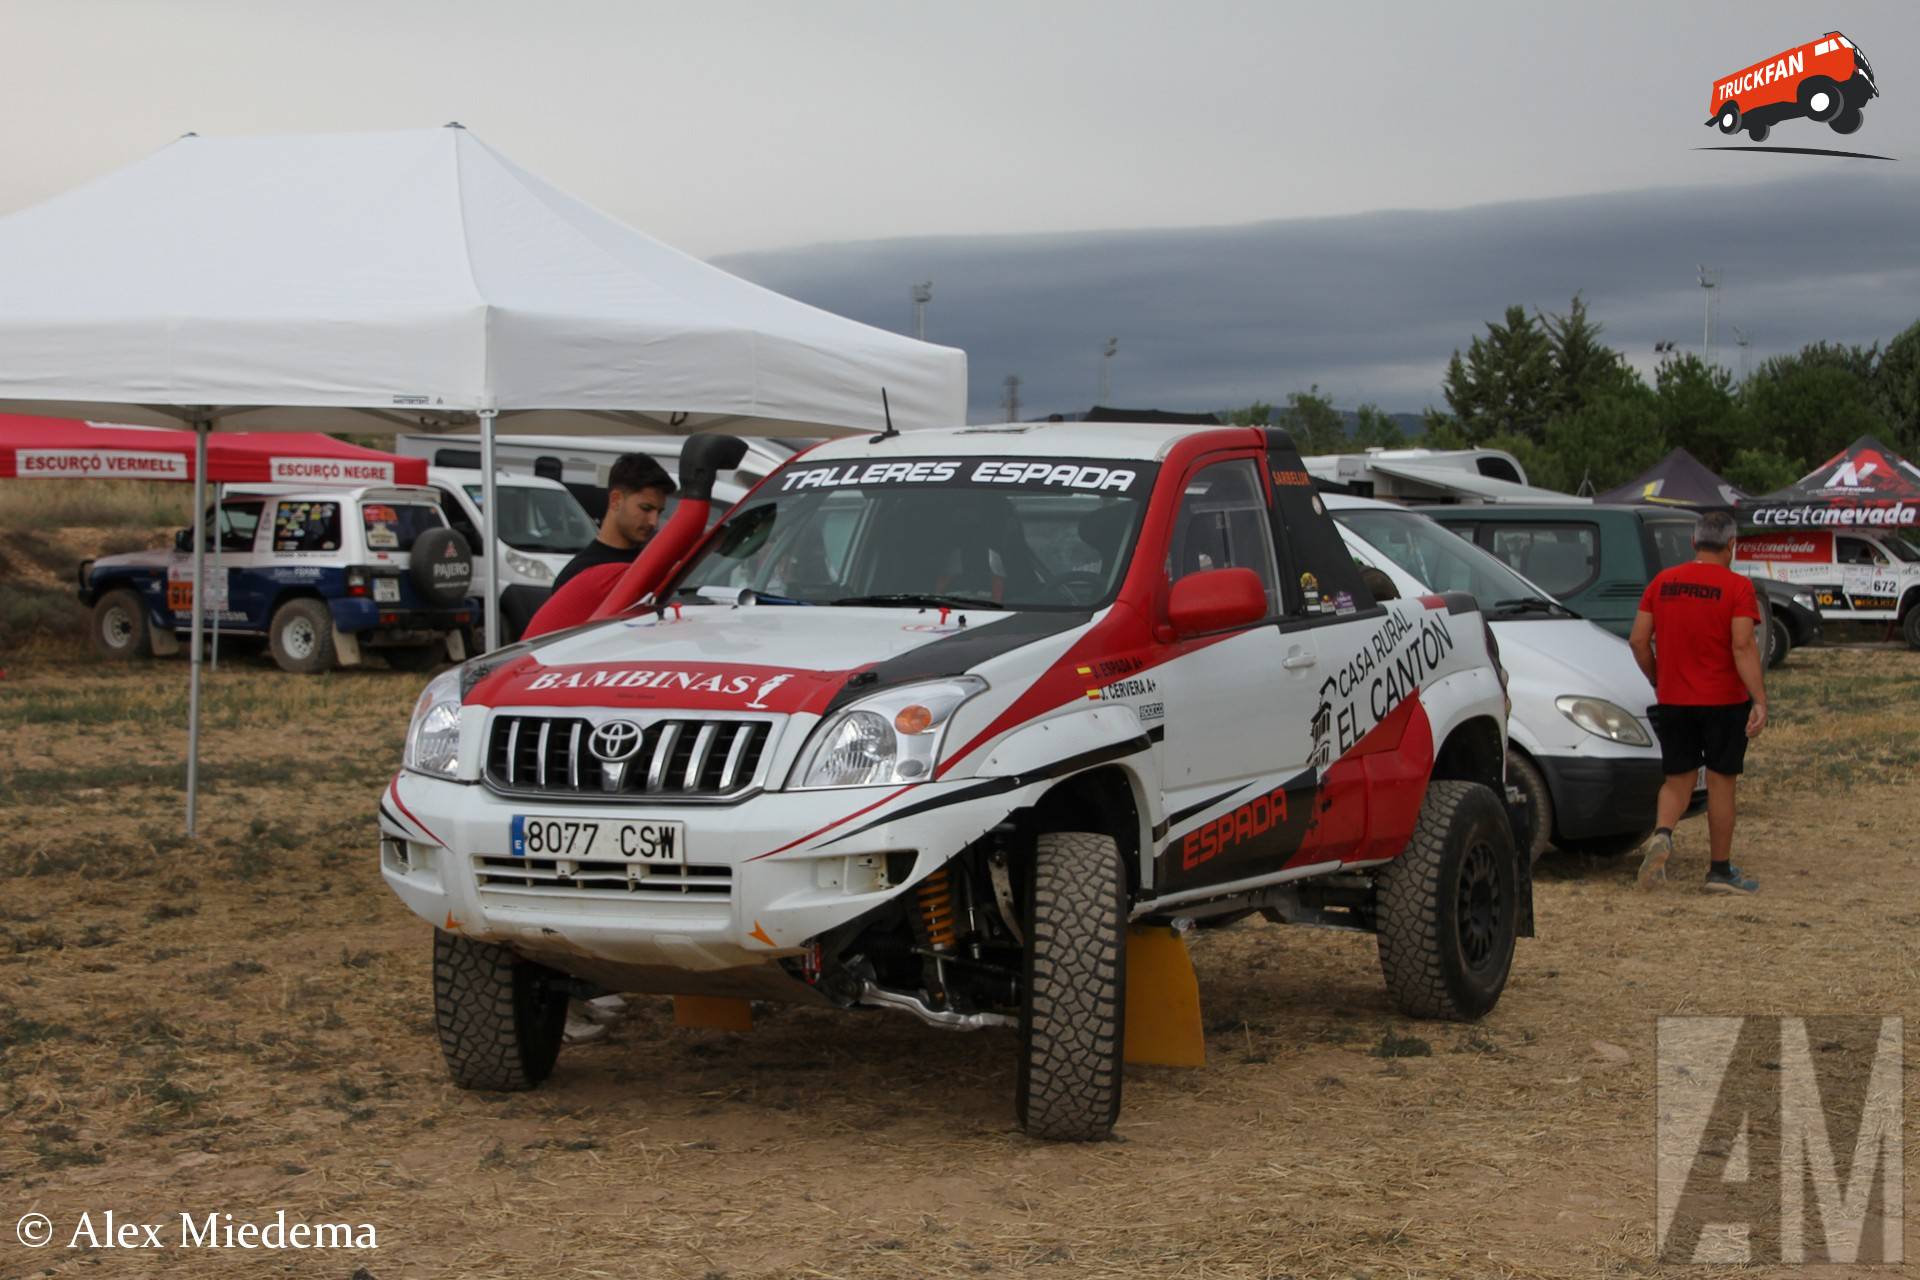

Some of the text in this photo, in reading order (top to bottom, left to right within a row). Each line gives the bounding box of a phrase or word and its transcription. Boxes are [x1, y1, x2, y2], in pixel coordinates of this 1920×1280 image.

[25, 454, 176, 473] ESCURÇÓ VERMELL
[278, 462, 386, 480] ESCURÇÓ NEGRE
[781, 461, 1136, 492] TALLERES ESPADA
[1752, 502, 1917, 526] crestanevada
[433, 562, 470, 578] PAJERO
[1873, 580, 1897, 592] 672
[1339, 646, 1375, 698] CASA
[1372, 607, 1413, 663] RURAL
[1099, 657, 1134, 677] ESPADA
[526, 670, 758, 694] BAMBINAS
[1108, 679, 1146, 699] CERVERA
[1146, 678, 1156, 693] A+
[1337, 612, 1454, 756] EL CANTÓN
[514, 821, 675, 858] E 8077 CSW
[1183, 786, 1288, 871] ESPADA
